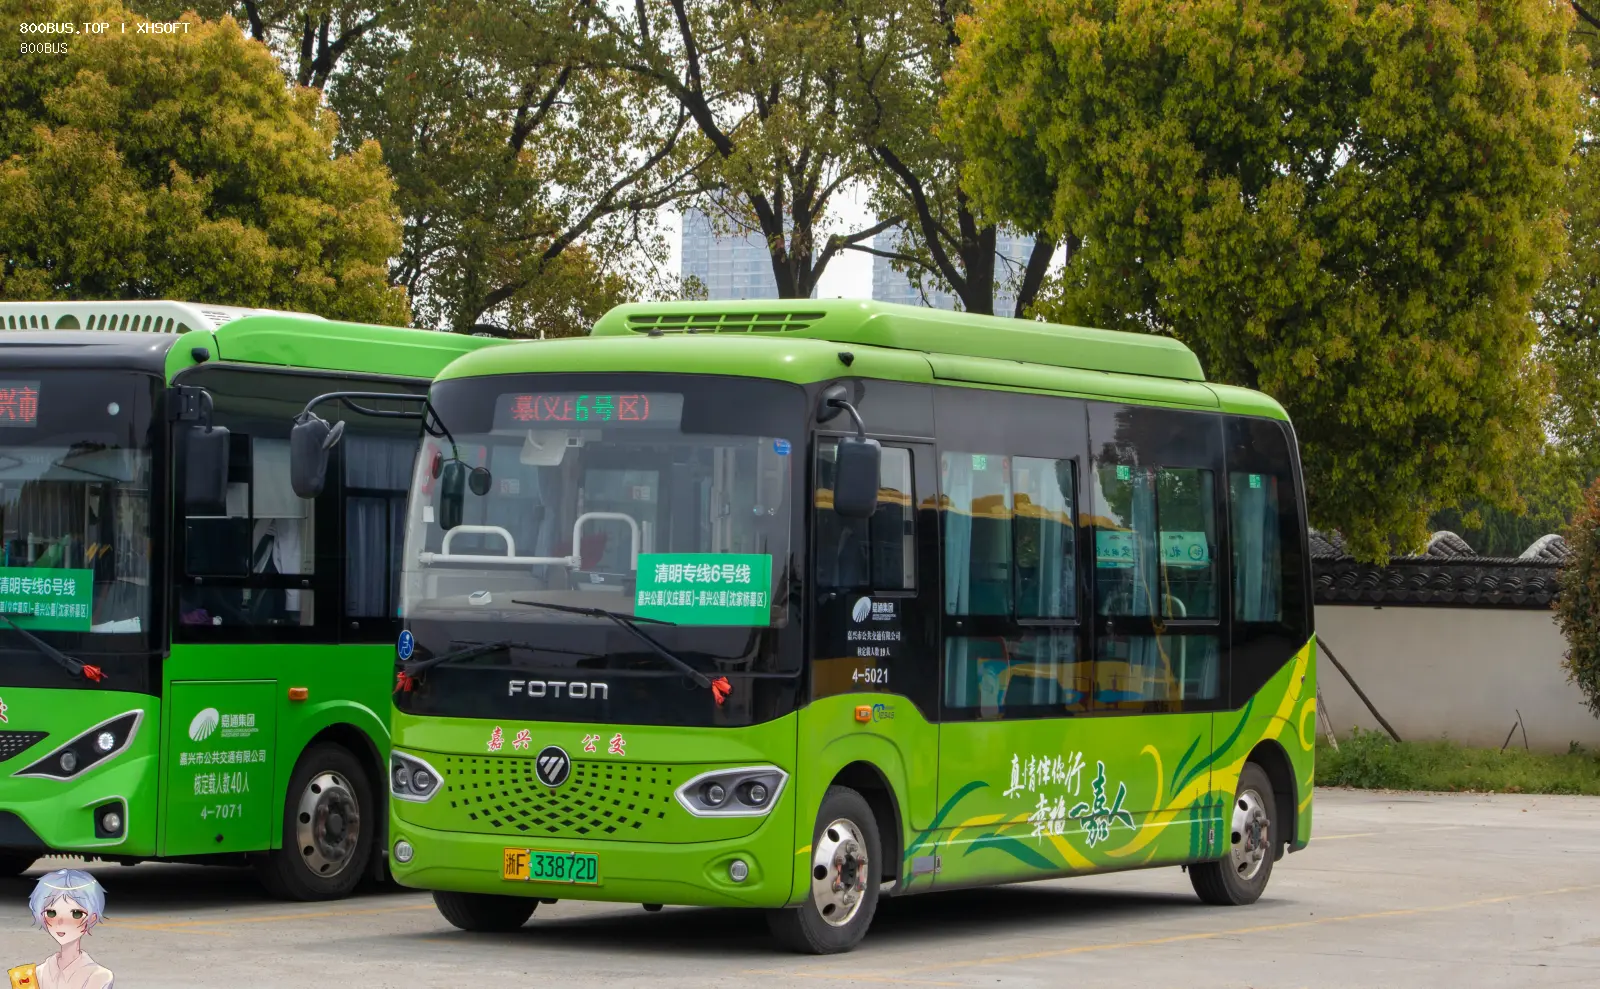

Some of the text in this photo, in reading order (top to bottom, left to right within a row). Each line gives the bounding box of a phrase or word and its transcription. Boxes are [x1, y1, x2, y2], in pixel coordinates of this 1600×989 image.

[654, 563, 751, 584] 清明专线6号线
[852, 667, 889, 683] 4-5021
[508, 680, 609, 700] FOTON
[221, 713, 256, 728] 嘉通集团
[180, 749, 267, 766] 嘉兴市公共交通有限公司
[193, 772, 250, 795] 核定载人数40人
[200, 804, 242, 820] 4-7071
